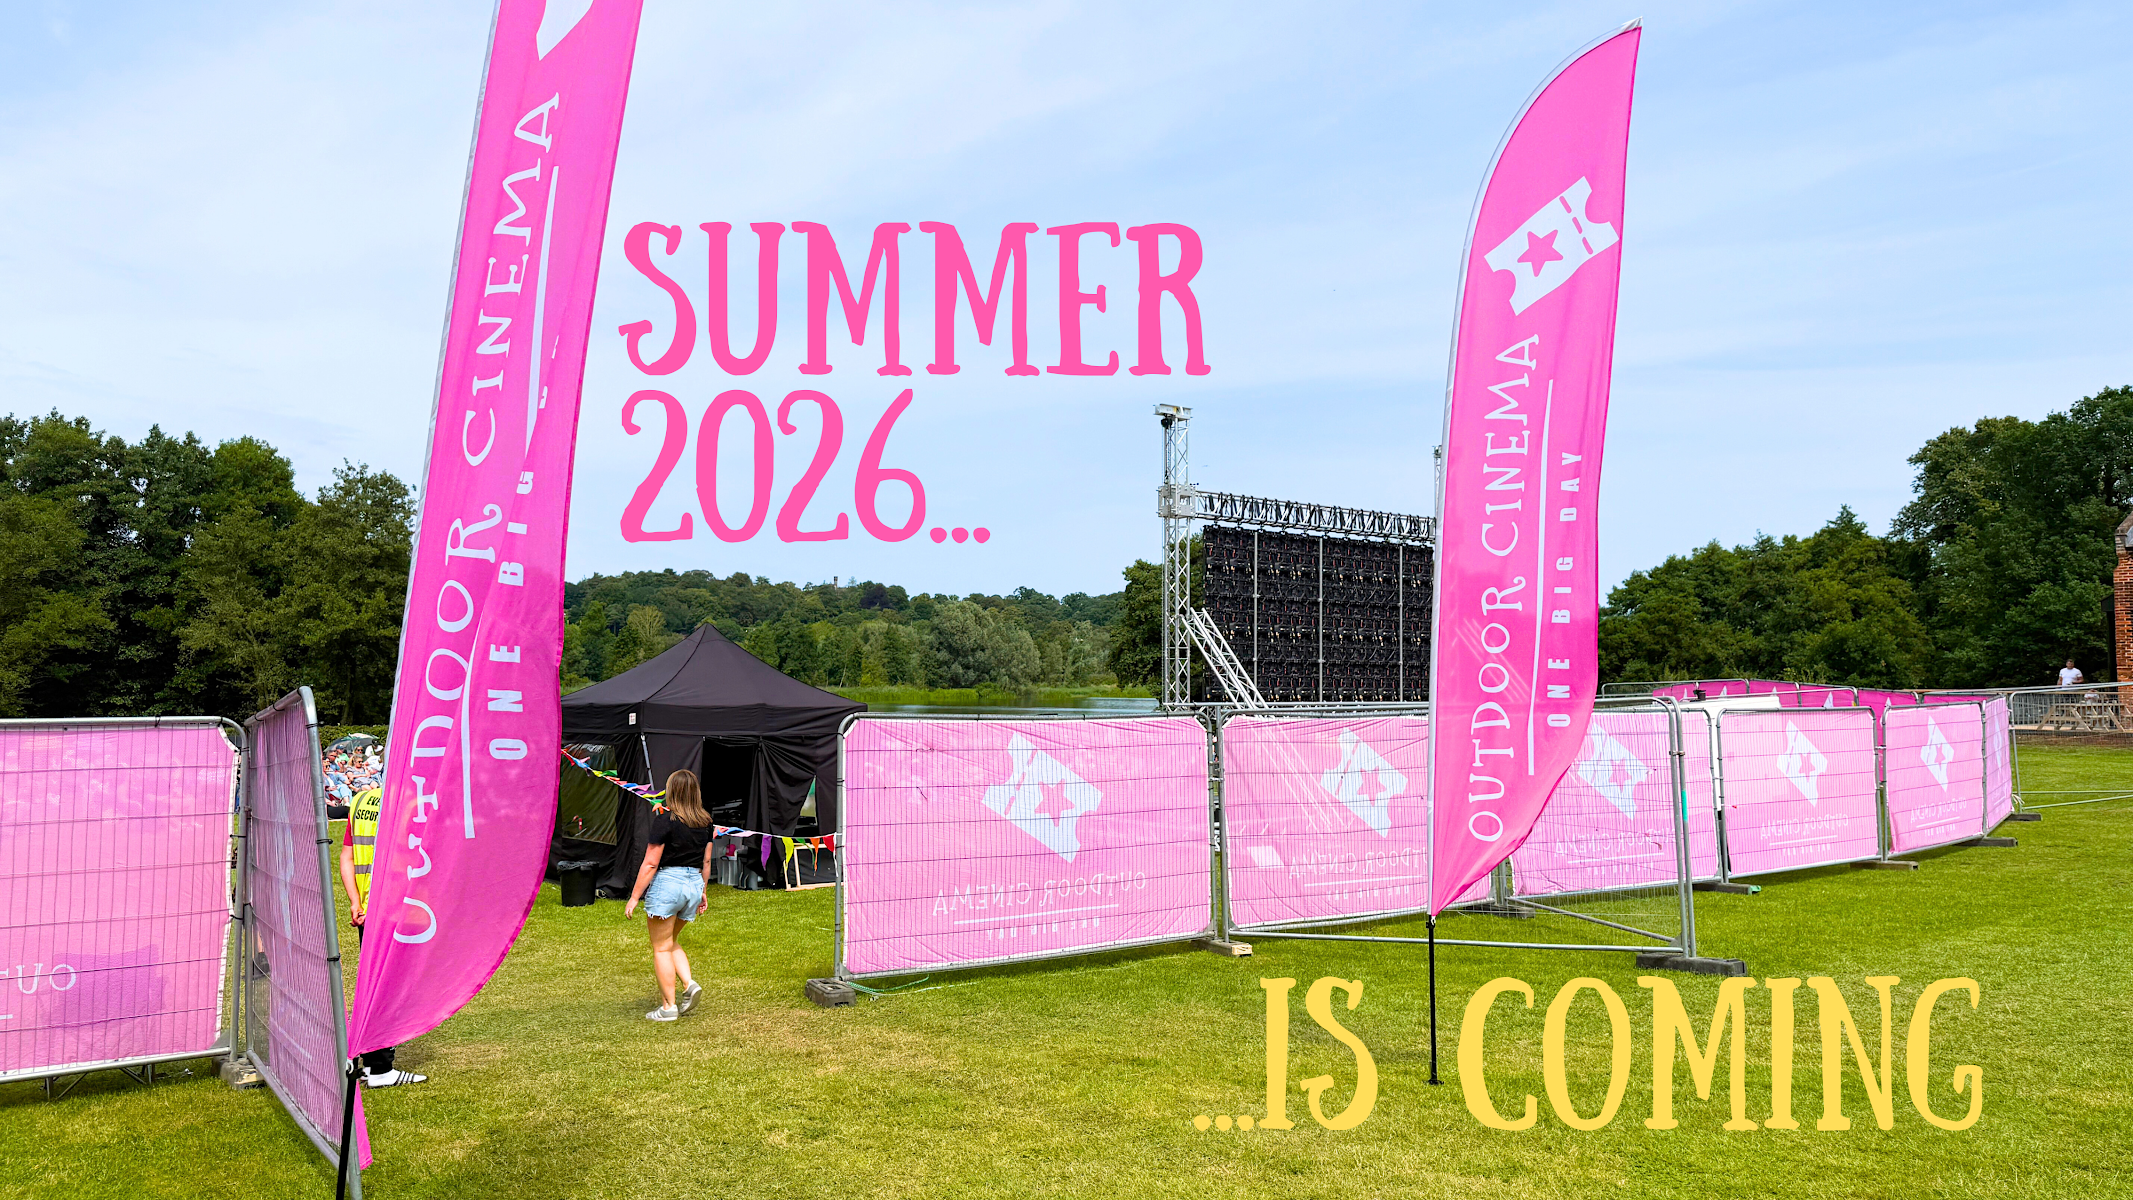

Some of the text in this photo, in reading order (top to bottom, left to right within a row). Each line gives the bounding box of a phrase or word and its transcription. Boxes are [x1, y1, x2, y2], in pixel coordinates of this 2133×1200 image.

[462, 92, 560, 467] CINEMA
[488, 643, 529, 760] ONE
[1468, 333, 1540, 842] OUTDOOR CINEMA
[1547, 452, 1583, 728] ONE BIG DAY
[356, 809, 379, 821] SECUR
